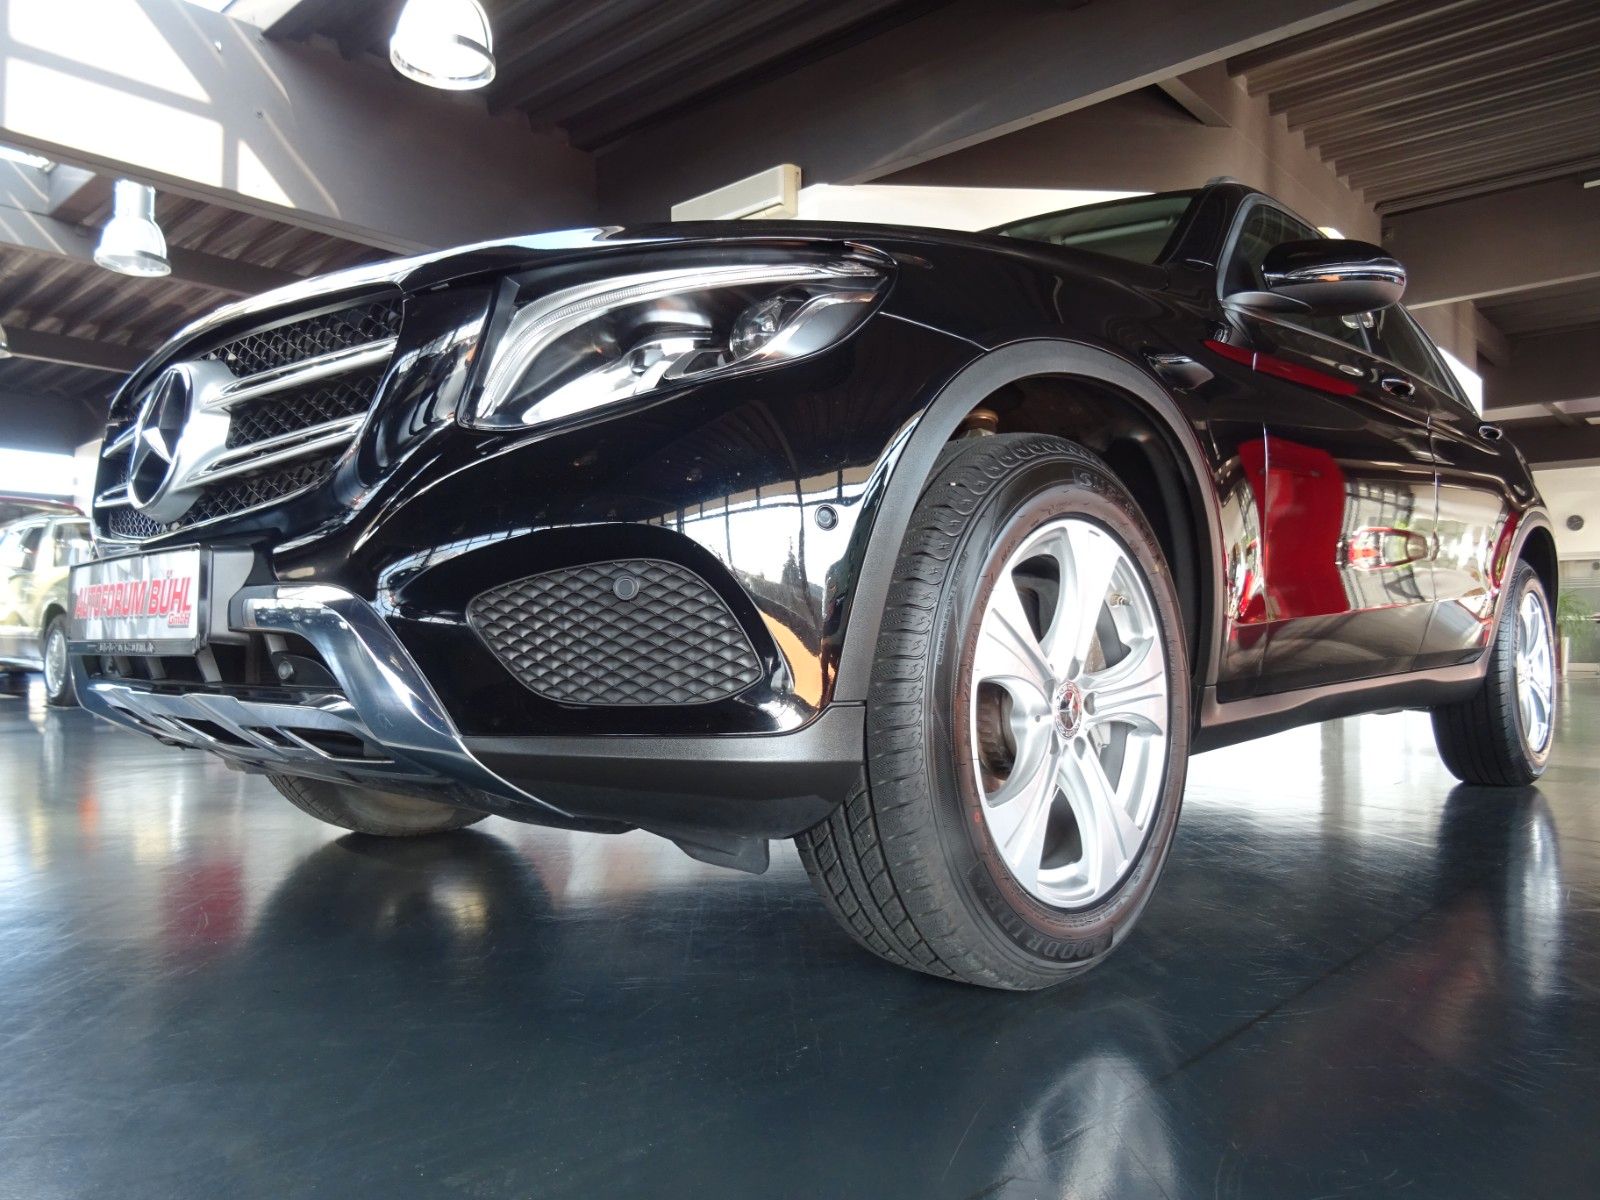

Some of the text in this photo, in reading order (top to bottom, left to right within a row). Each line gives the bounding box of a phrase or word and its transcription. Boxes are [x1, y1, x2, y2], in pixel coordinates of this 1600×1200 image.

[74, 569, 192, 619] AUTOFORUM BÜHL
[985, 891, 1104, 960] OODRIDE
